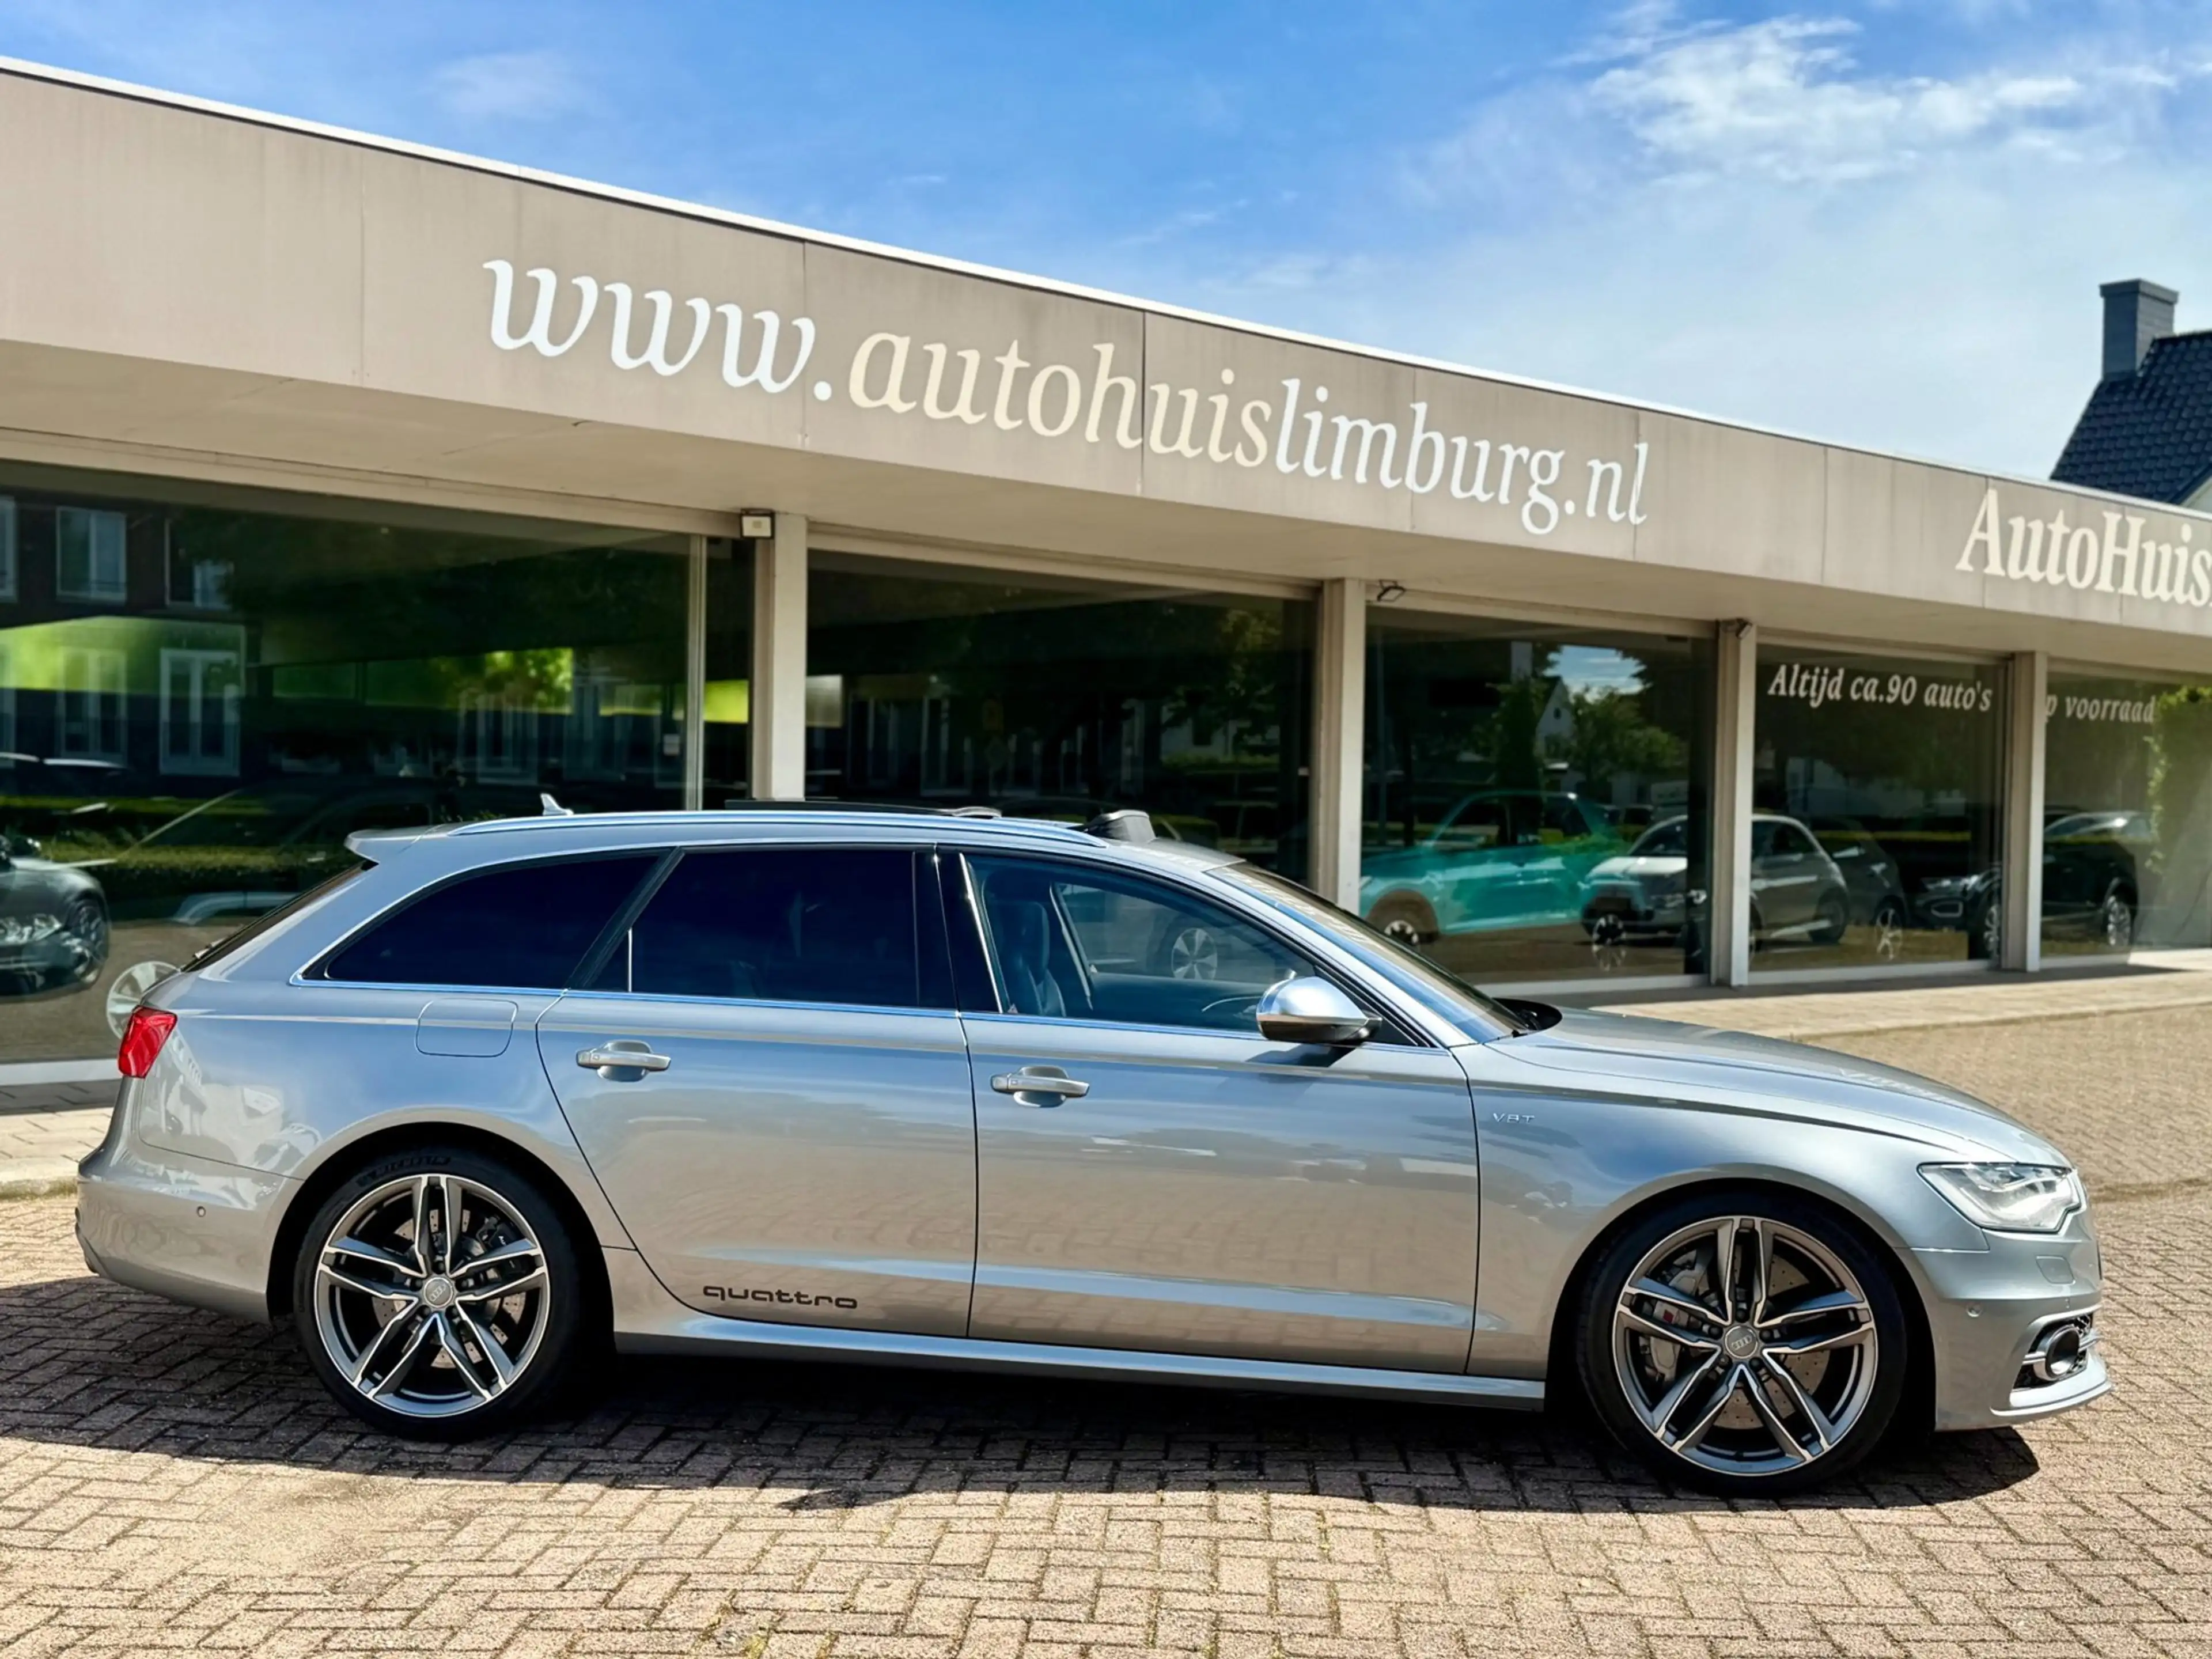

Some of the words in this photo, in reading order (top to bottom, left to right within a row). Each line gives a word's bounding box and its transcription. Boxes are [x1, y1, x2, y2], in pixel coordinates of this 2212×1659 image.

[1955, 488, 2212, 608] AutoHuis
[1767, 664, 1844, 709] Altijd
[1850, 674, 1918, 706] ca.90
[1923, 680, 1993, 712] auto's
[2065, 695, 2156, 724] voorraad
[703, 1285, 858, 1309] quattro
